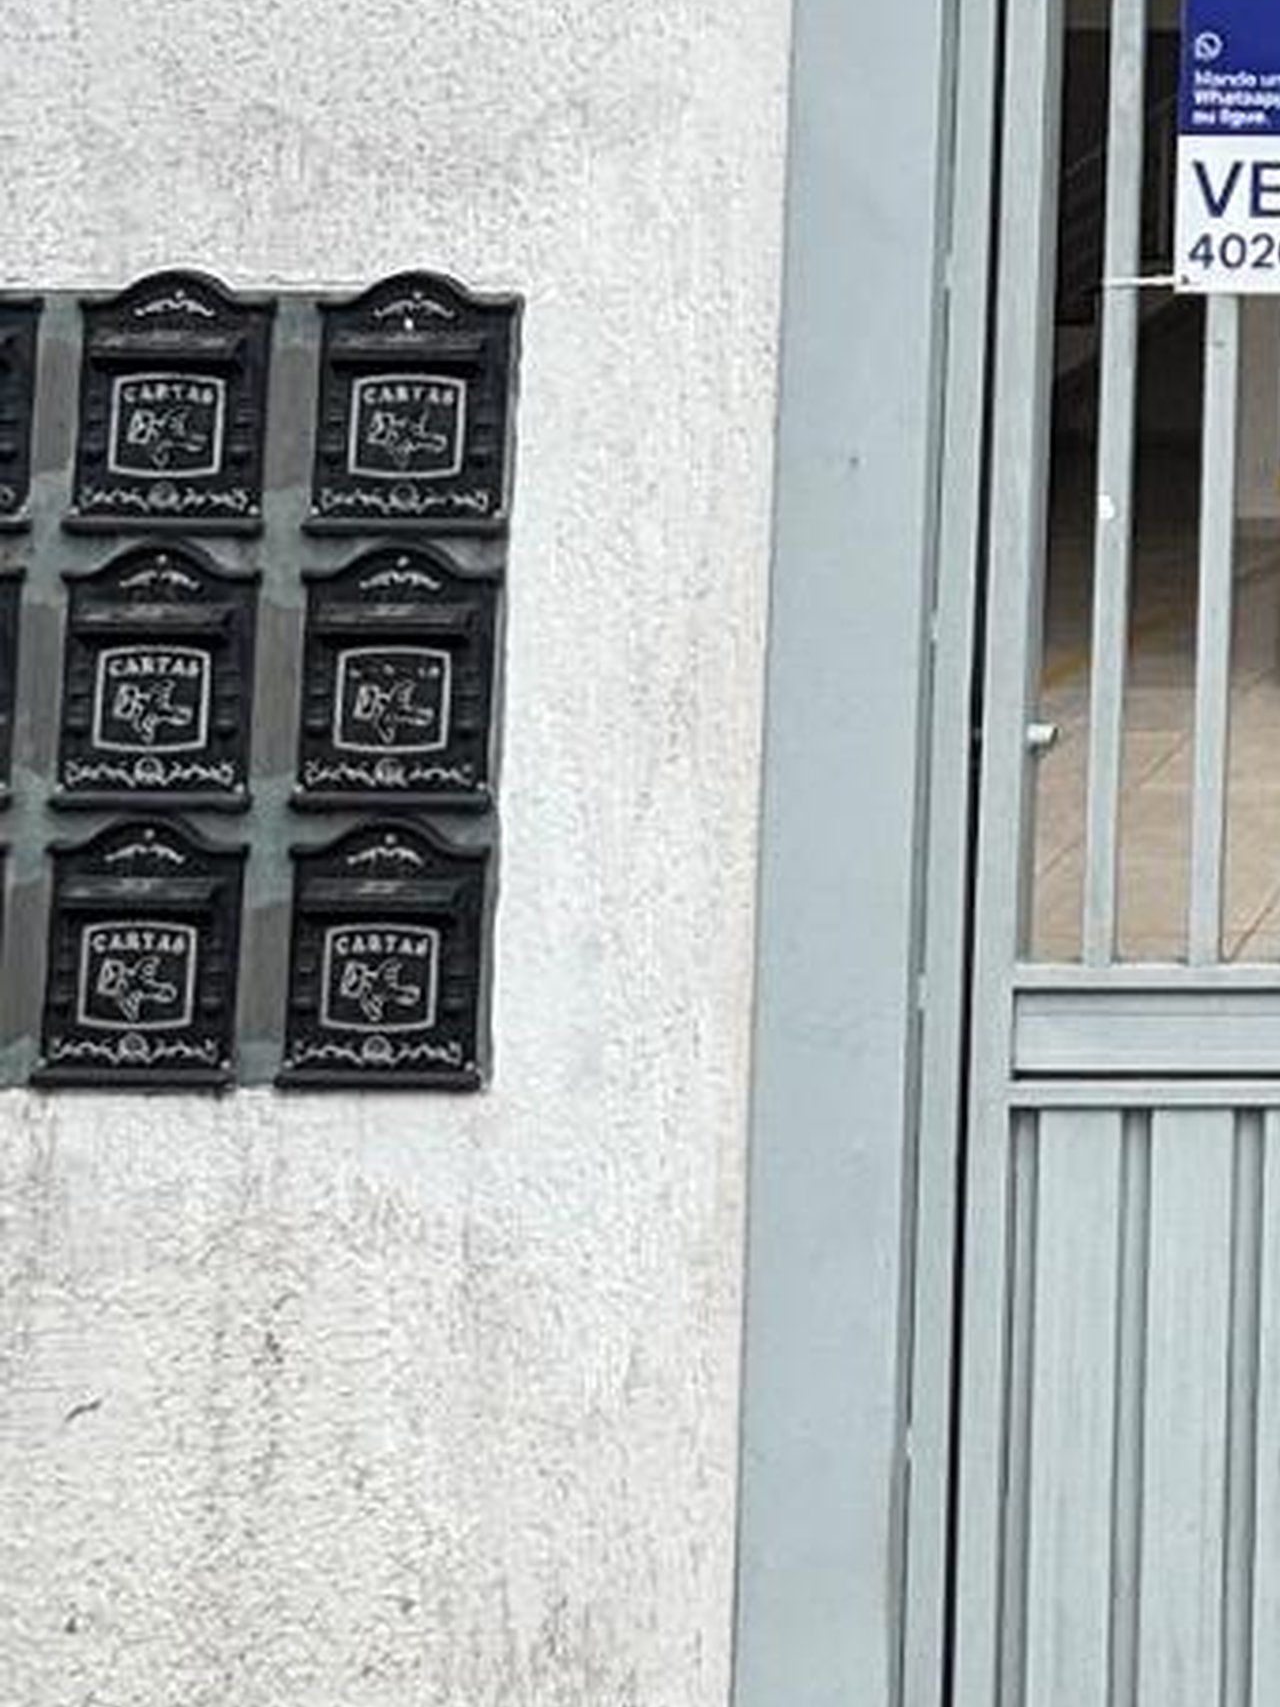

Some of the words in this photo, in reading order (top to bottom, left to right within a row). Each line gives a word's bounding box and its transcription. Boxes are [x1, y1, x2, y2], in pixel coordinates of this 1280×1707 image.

[123, 384, 214, 405] CARTAS
[362, 385, 455, 406] CARTAS
[107, 657, 200, 678] CARTAS
[91, 932, 187, 956] CARTAS
[334, 934, 430, 957] CARTAS
